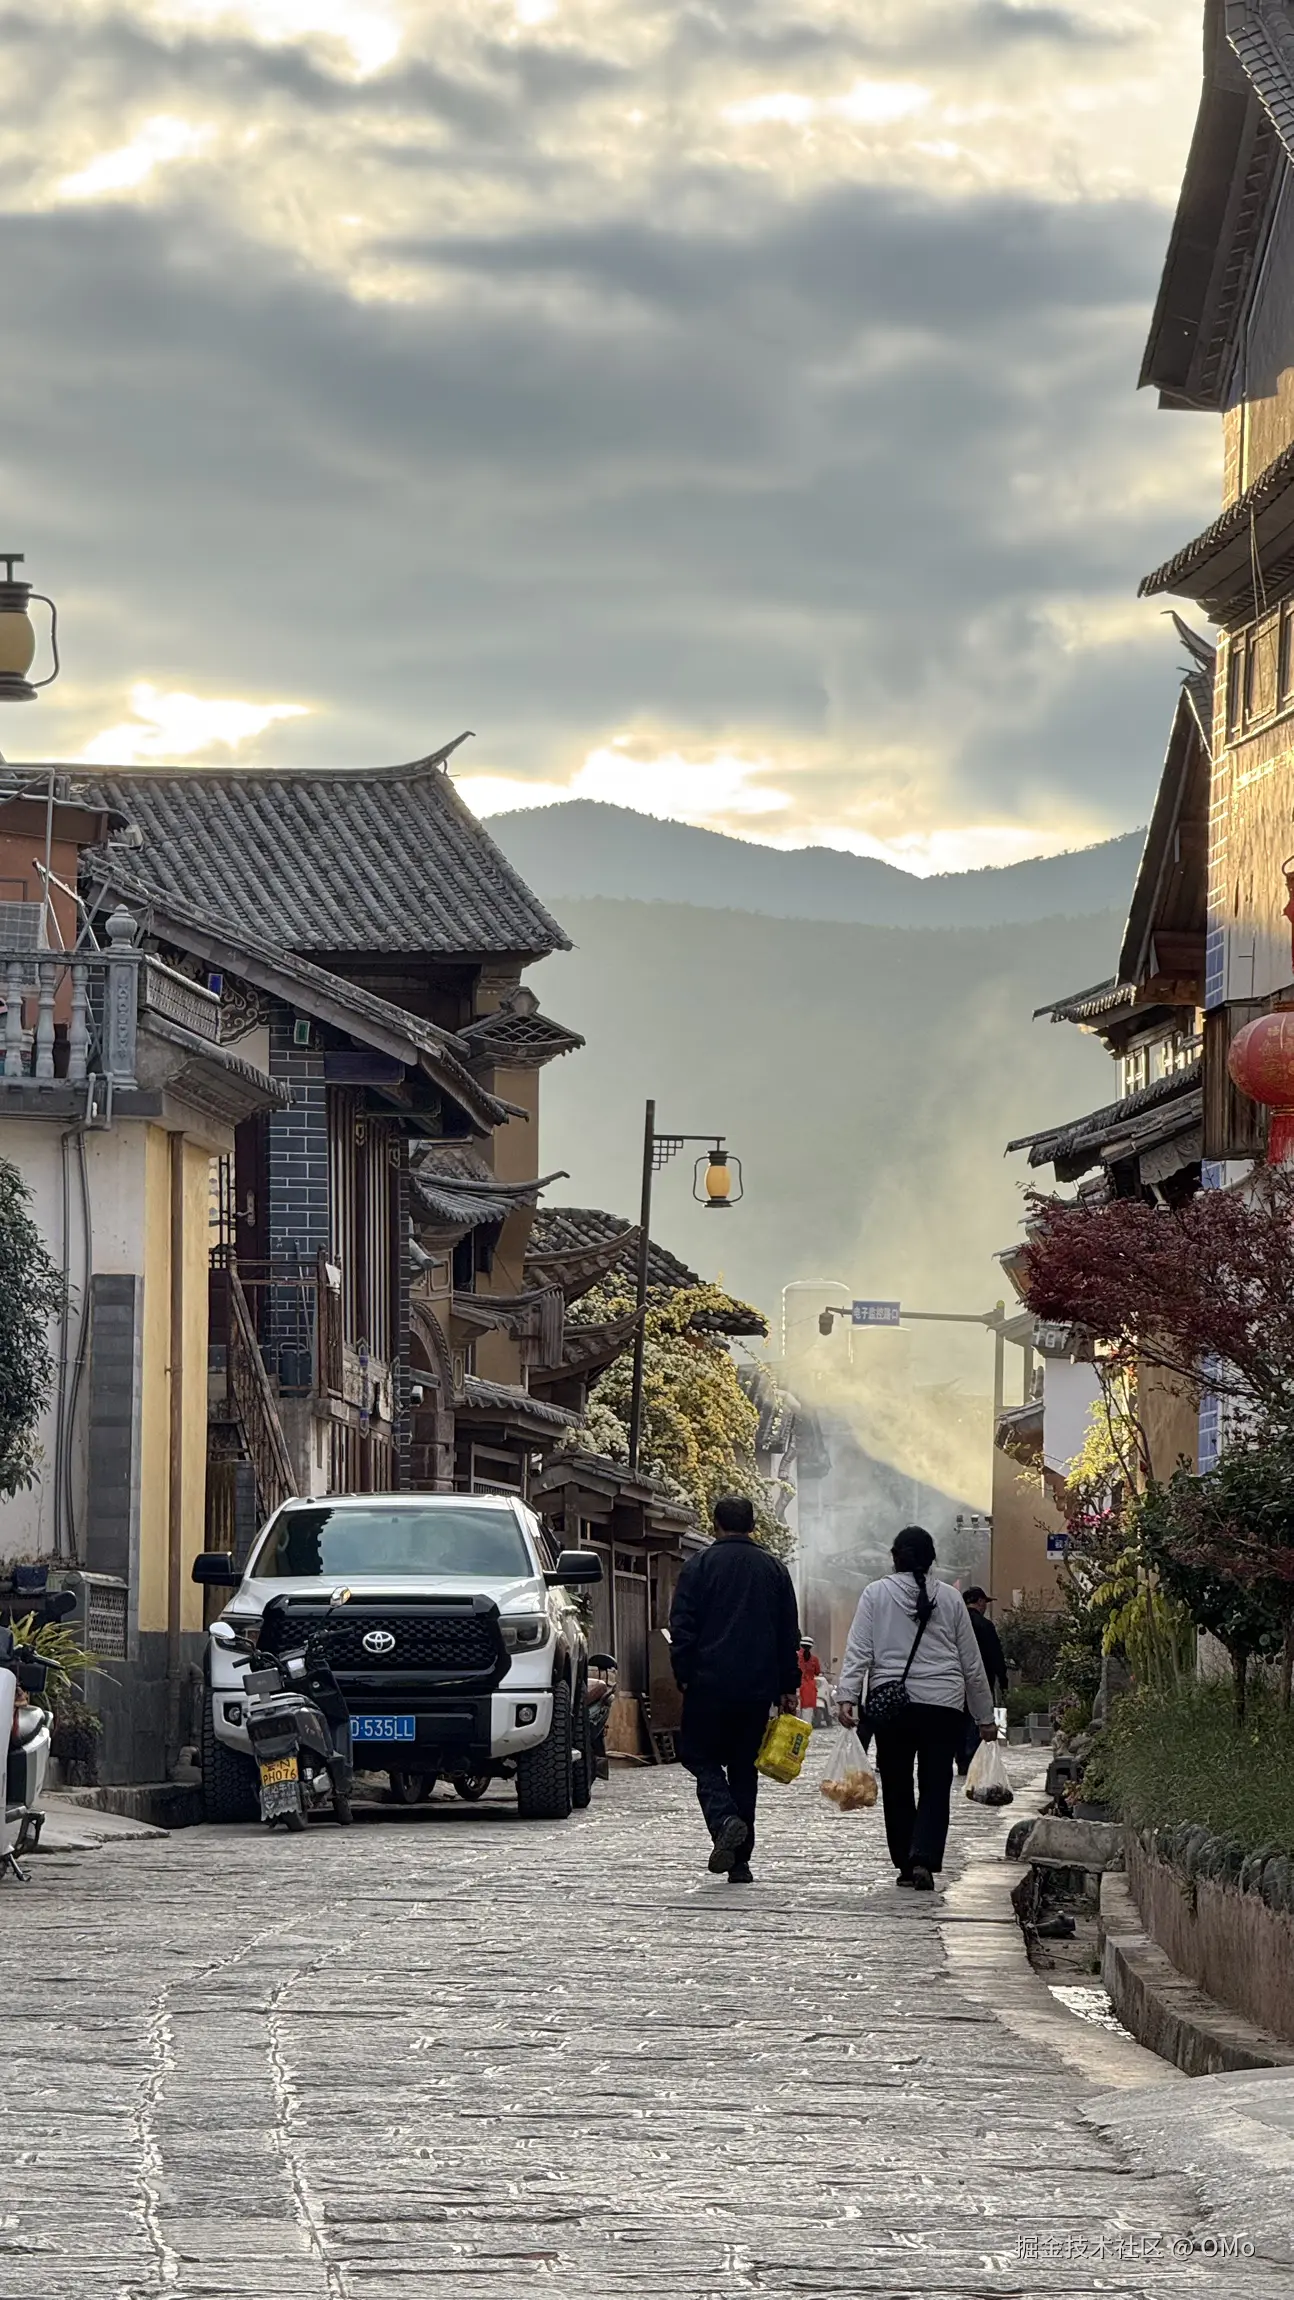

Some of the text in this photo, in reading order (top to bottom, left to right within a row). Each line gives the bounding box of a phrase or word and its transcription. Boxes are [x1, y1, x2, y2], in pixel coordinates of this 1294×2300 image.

[854, 1306, 899, 1320] 电子监控路口
